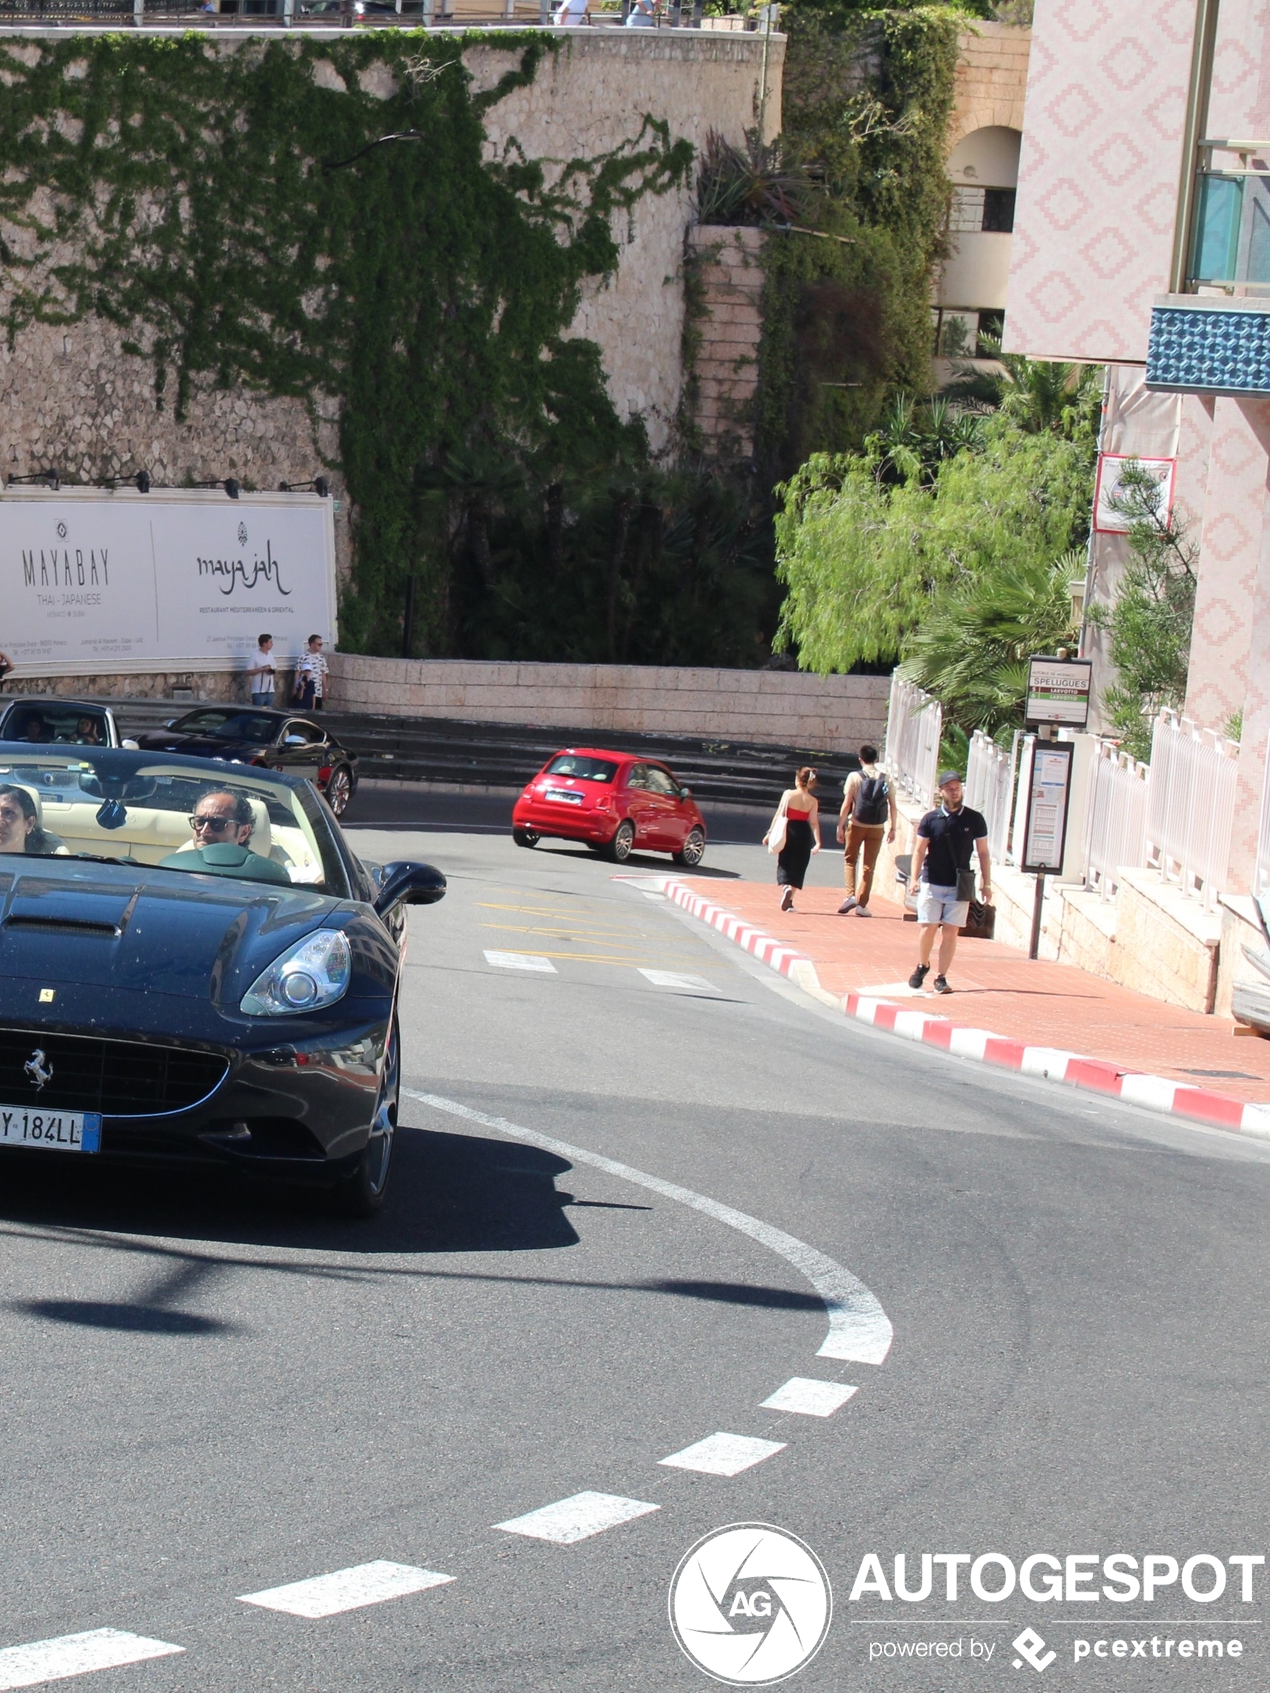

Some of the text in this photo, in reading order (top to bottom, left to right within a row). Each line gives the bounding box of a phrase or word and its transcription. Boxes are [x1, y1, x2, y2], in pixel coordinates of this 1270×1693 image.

[22, 549, 108, 586] MAYABAY
[37, 594, 55, 606] THAI
[62, 593, 101, 606] JAPANESE
[1034, 677, 1086, 688] SPELUGUES
[22, 1114, 80, 1144] 184LL
